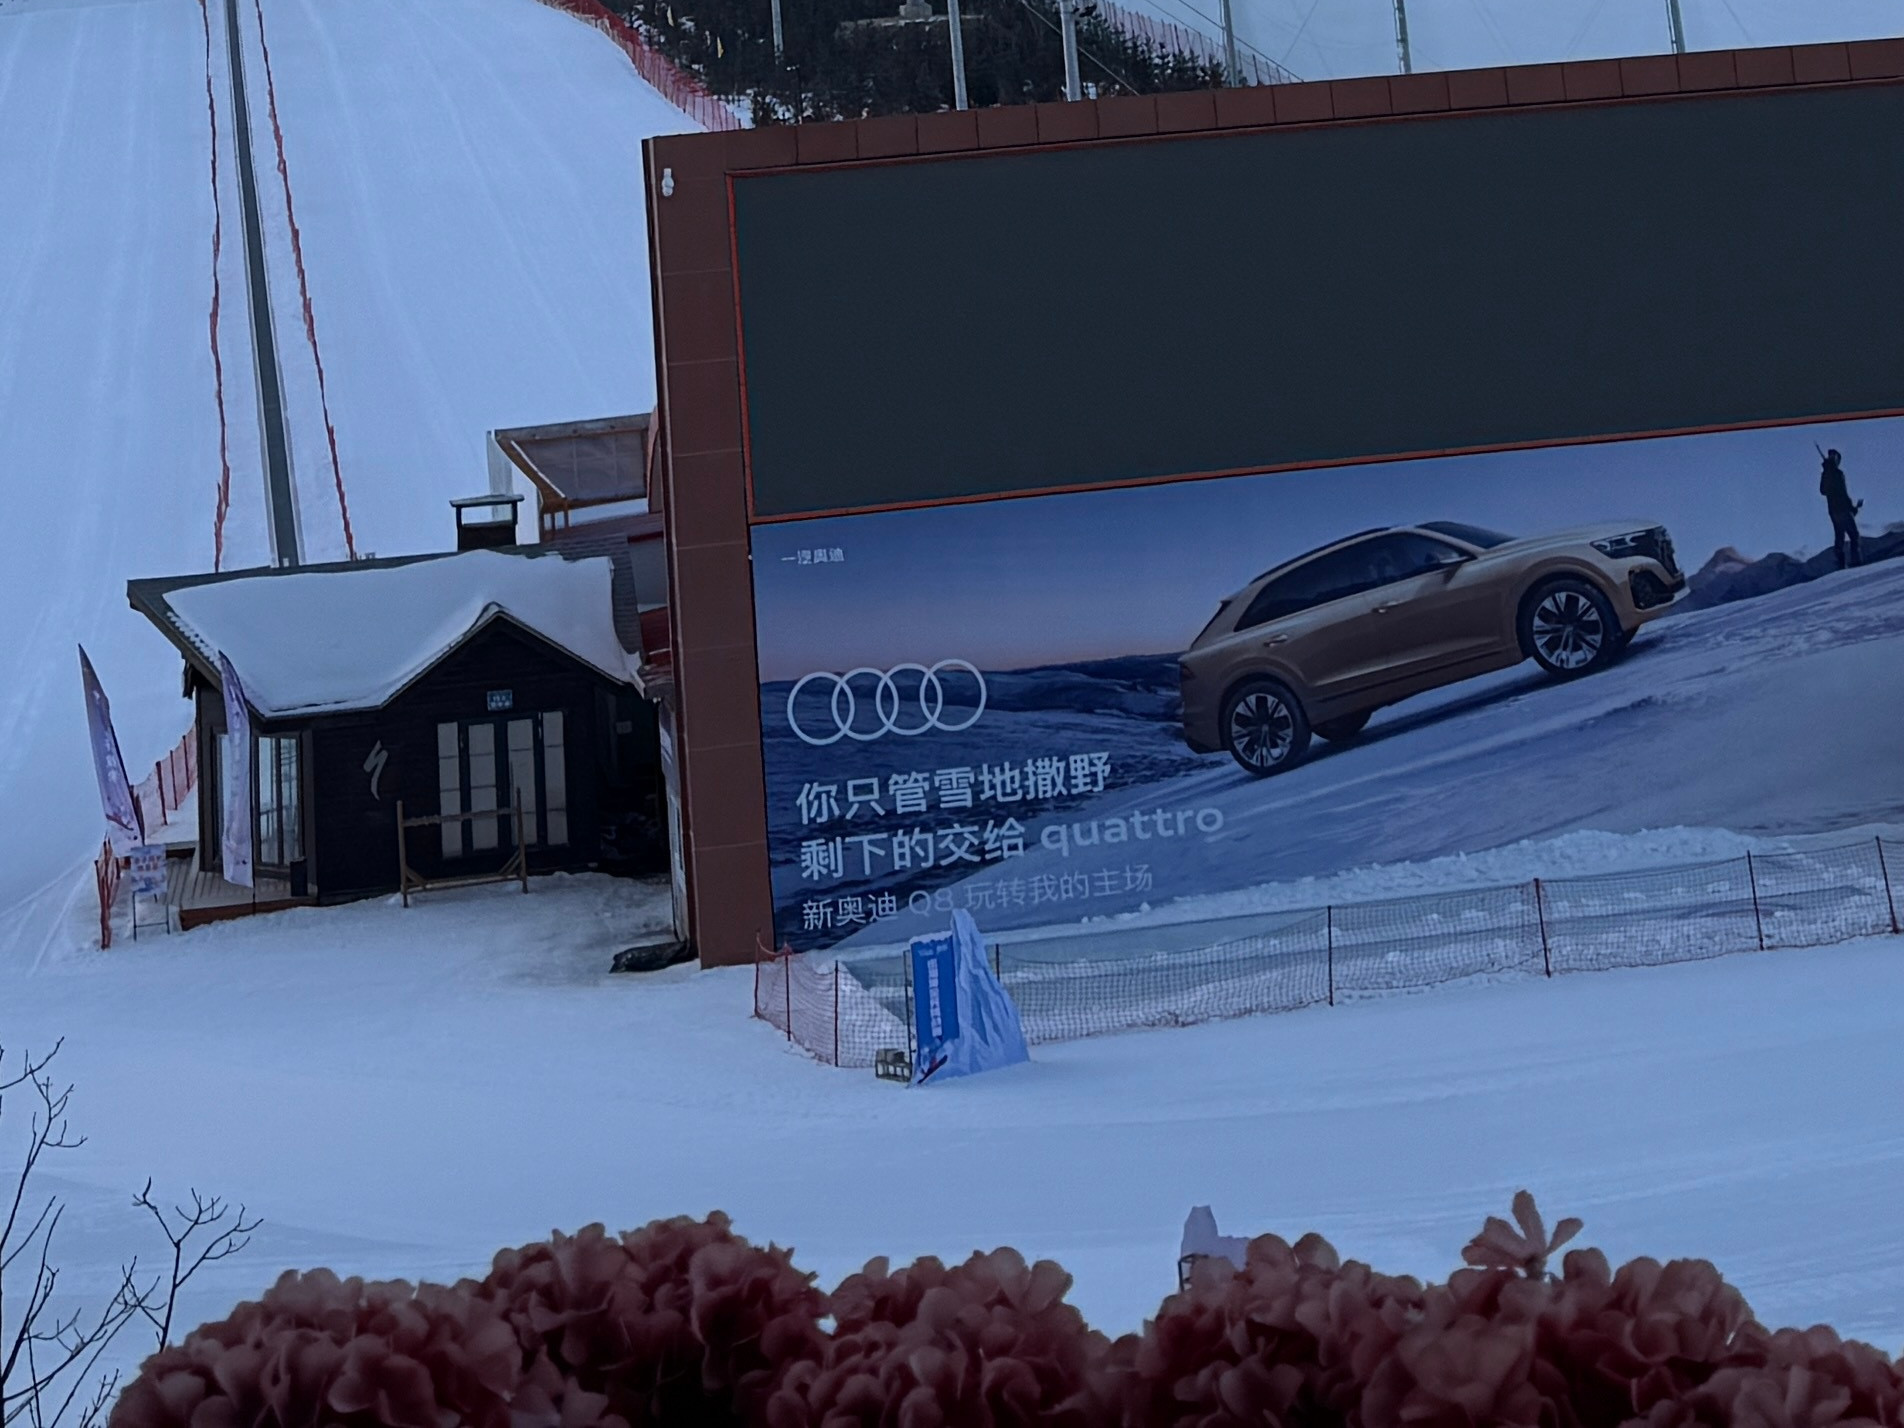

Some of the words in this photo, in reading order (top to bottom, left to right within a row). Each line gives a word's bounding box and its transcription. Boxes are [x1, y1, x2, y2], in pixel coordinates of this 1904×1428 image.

[795, 751, 1112, 826] 你只管雪地撒野
[800, 817, 1026, 882] 剩下的交给
[1039, 805, 1225, 857] quattro
[802, 891, 898, 931] 新奥迪
[908, 887, 955, 917] Q8
[963, 863, 1154, 913] 玩转我的主场
